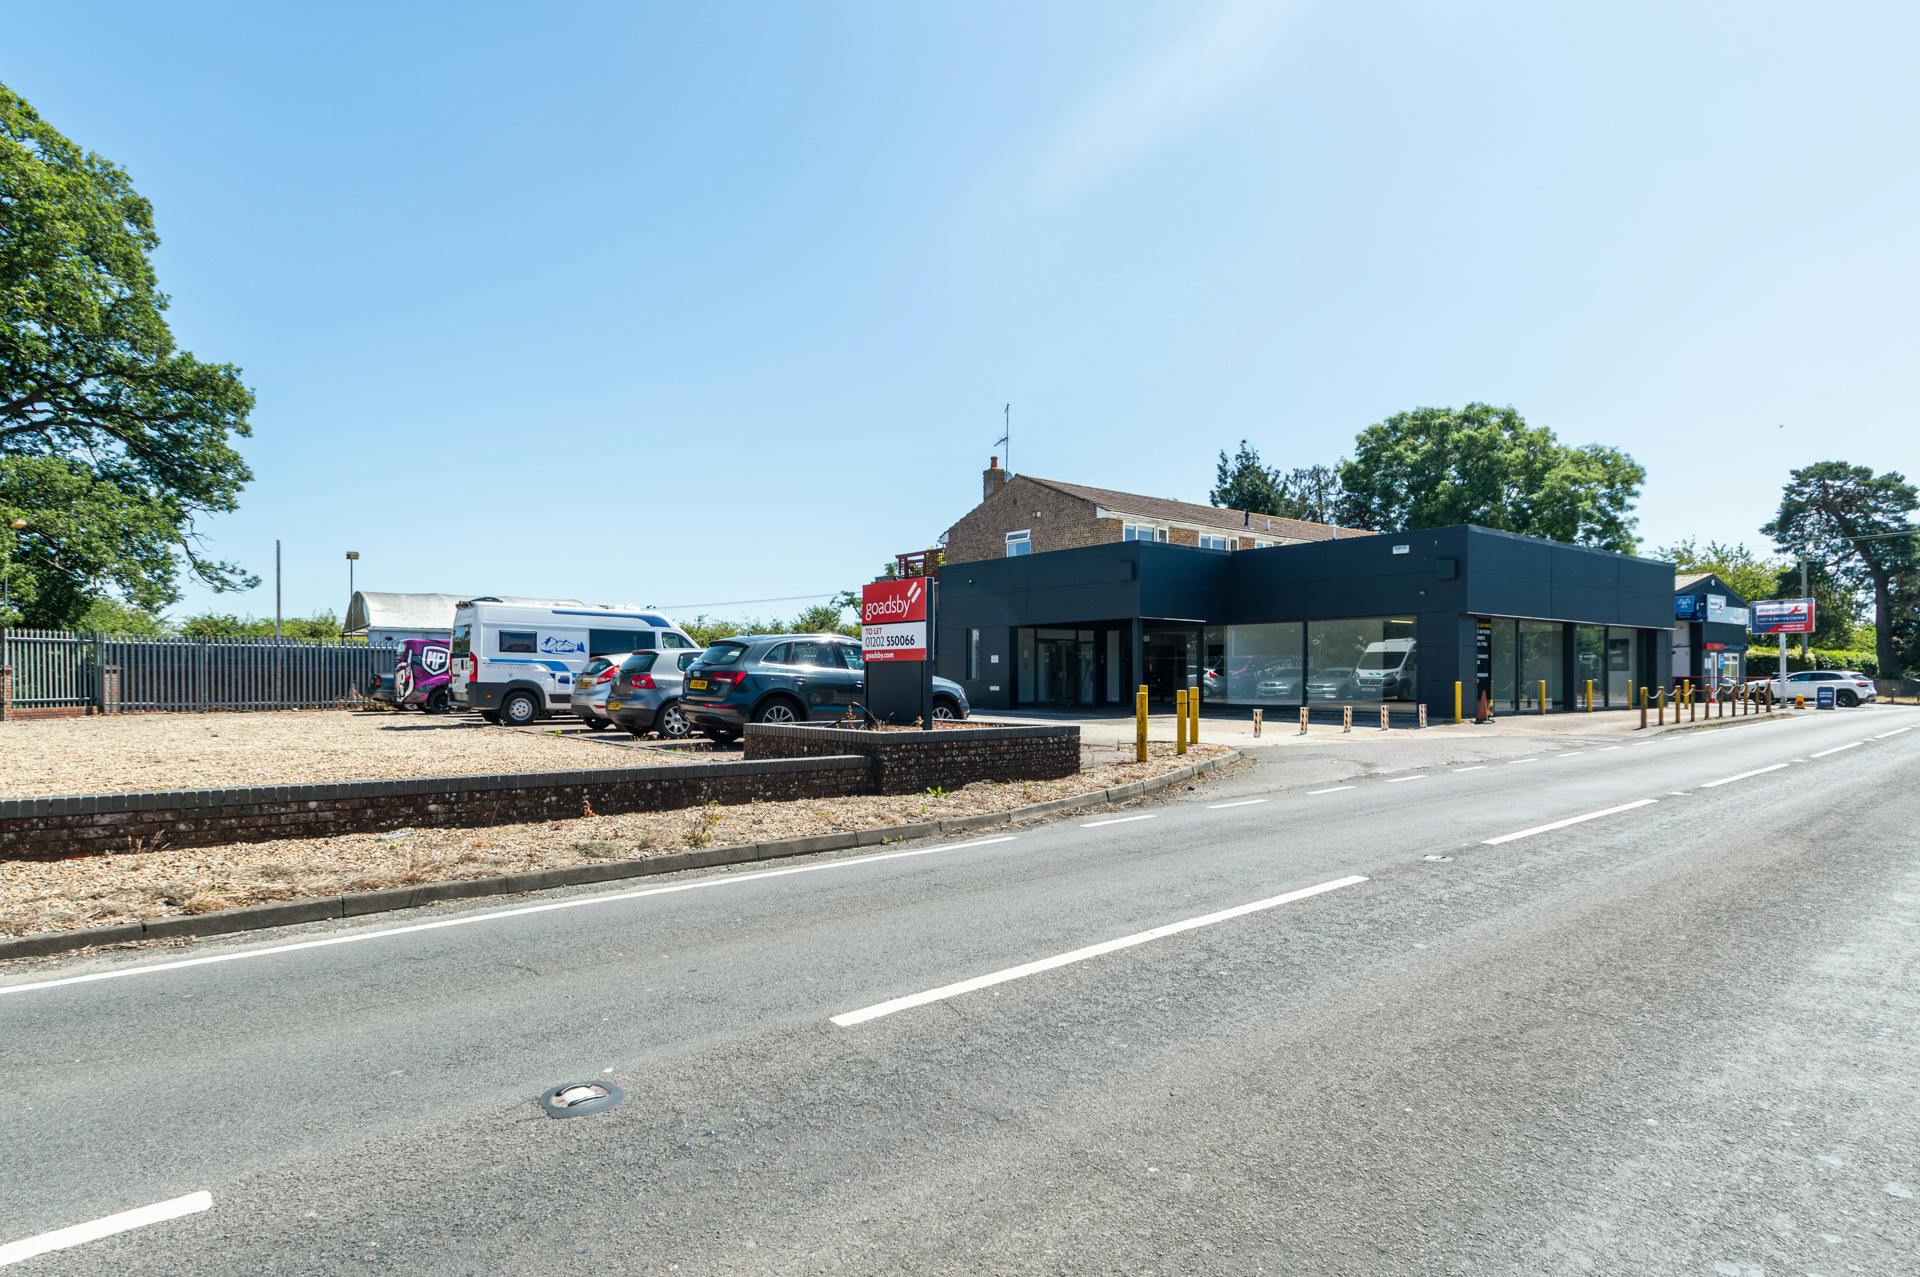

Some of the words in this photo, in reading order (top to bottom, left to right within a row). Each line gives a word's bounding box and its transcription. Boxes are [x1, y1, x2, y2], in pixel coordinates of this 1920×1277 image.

[865, 594, 911, 621] goadsby
[873, 627, 882, 635] LET
[865, 636, 885, 648] 01202
[886, 634, 915, 647] 550066
[426, 651, 446, 670] HP
[865, 651, 895, 661] goadsby.com
